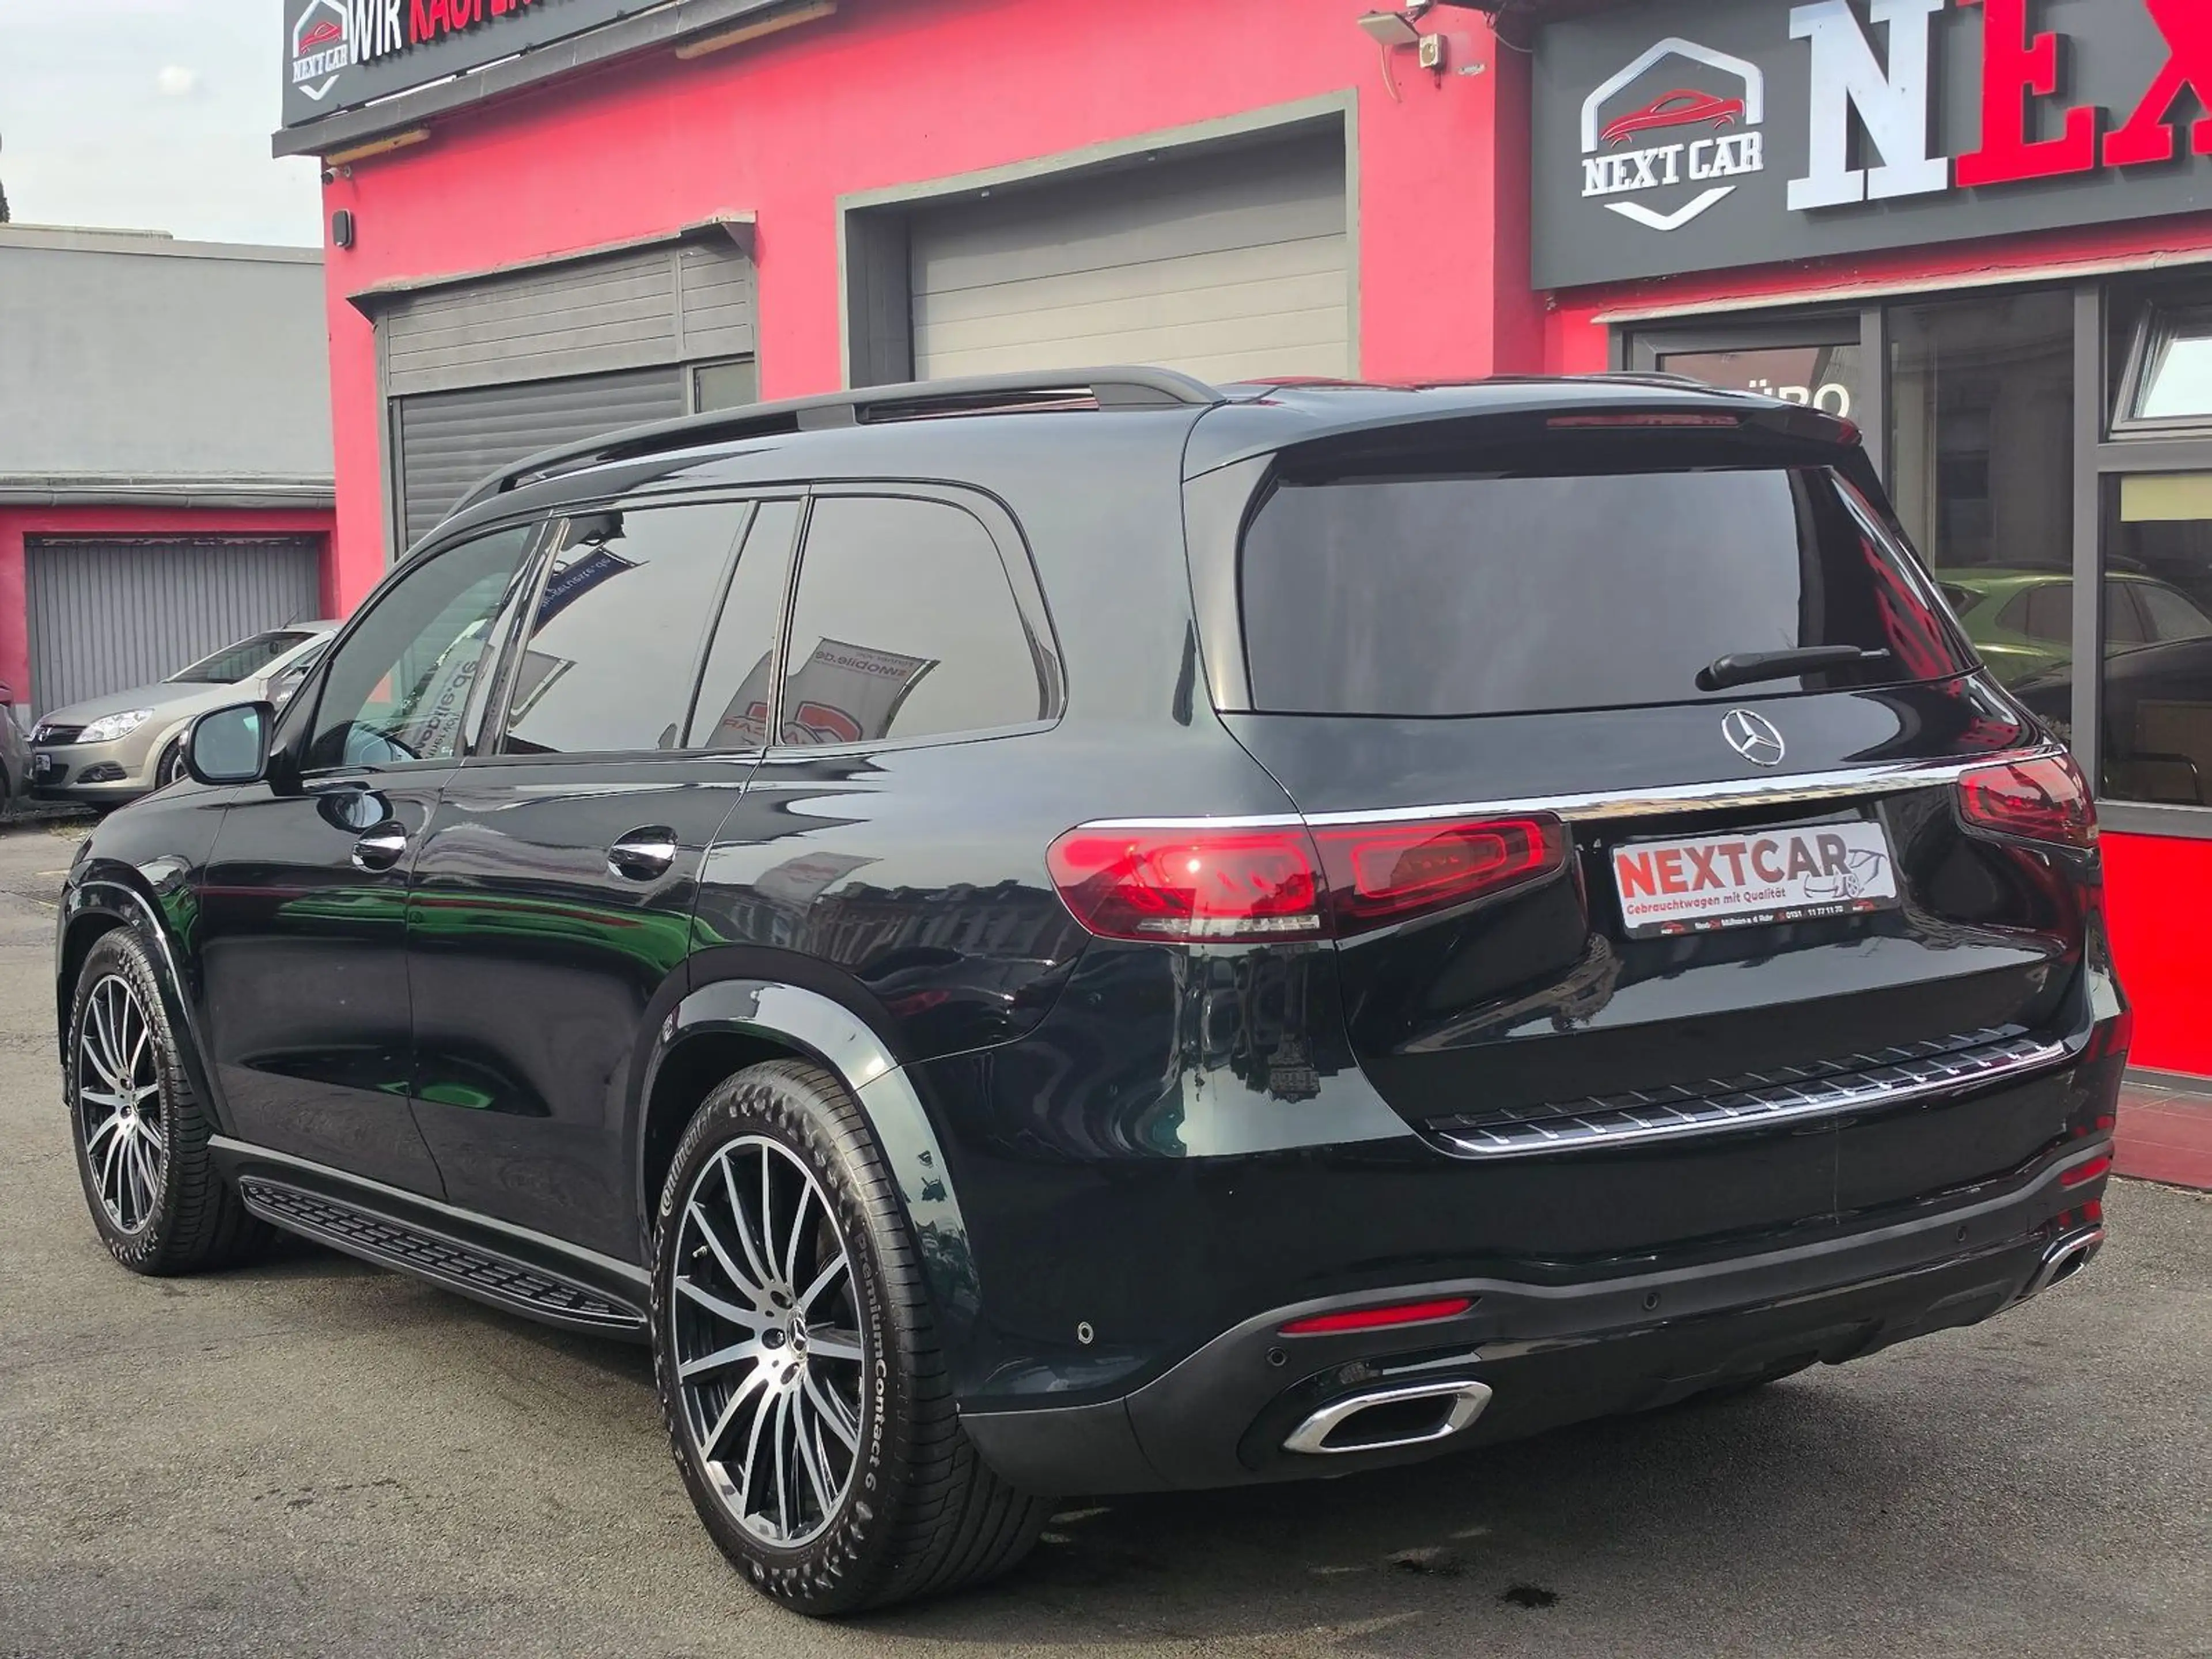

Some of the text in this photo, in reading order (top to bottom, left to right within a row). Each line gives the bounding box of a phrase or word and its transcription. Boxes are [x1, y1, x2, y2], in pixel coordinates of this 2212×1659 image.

[292, 44, 348, 84] NEXT CAR
[347, 0, 531, 65] WIR KAU
[1582, 131, 1764, 197] NEXT CAR
[1615, 833, 1851, 899] NEXTCAR
[1627, 887, 1786, 915] Gebrauchtwagen mit Qualität
[661, 1105, 713, 1217] Continental
[855, 1232, 888, 1492] PremiumContact 6
